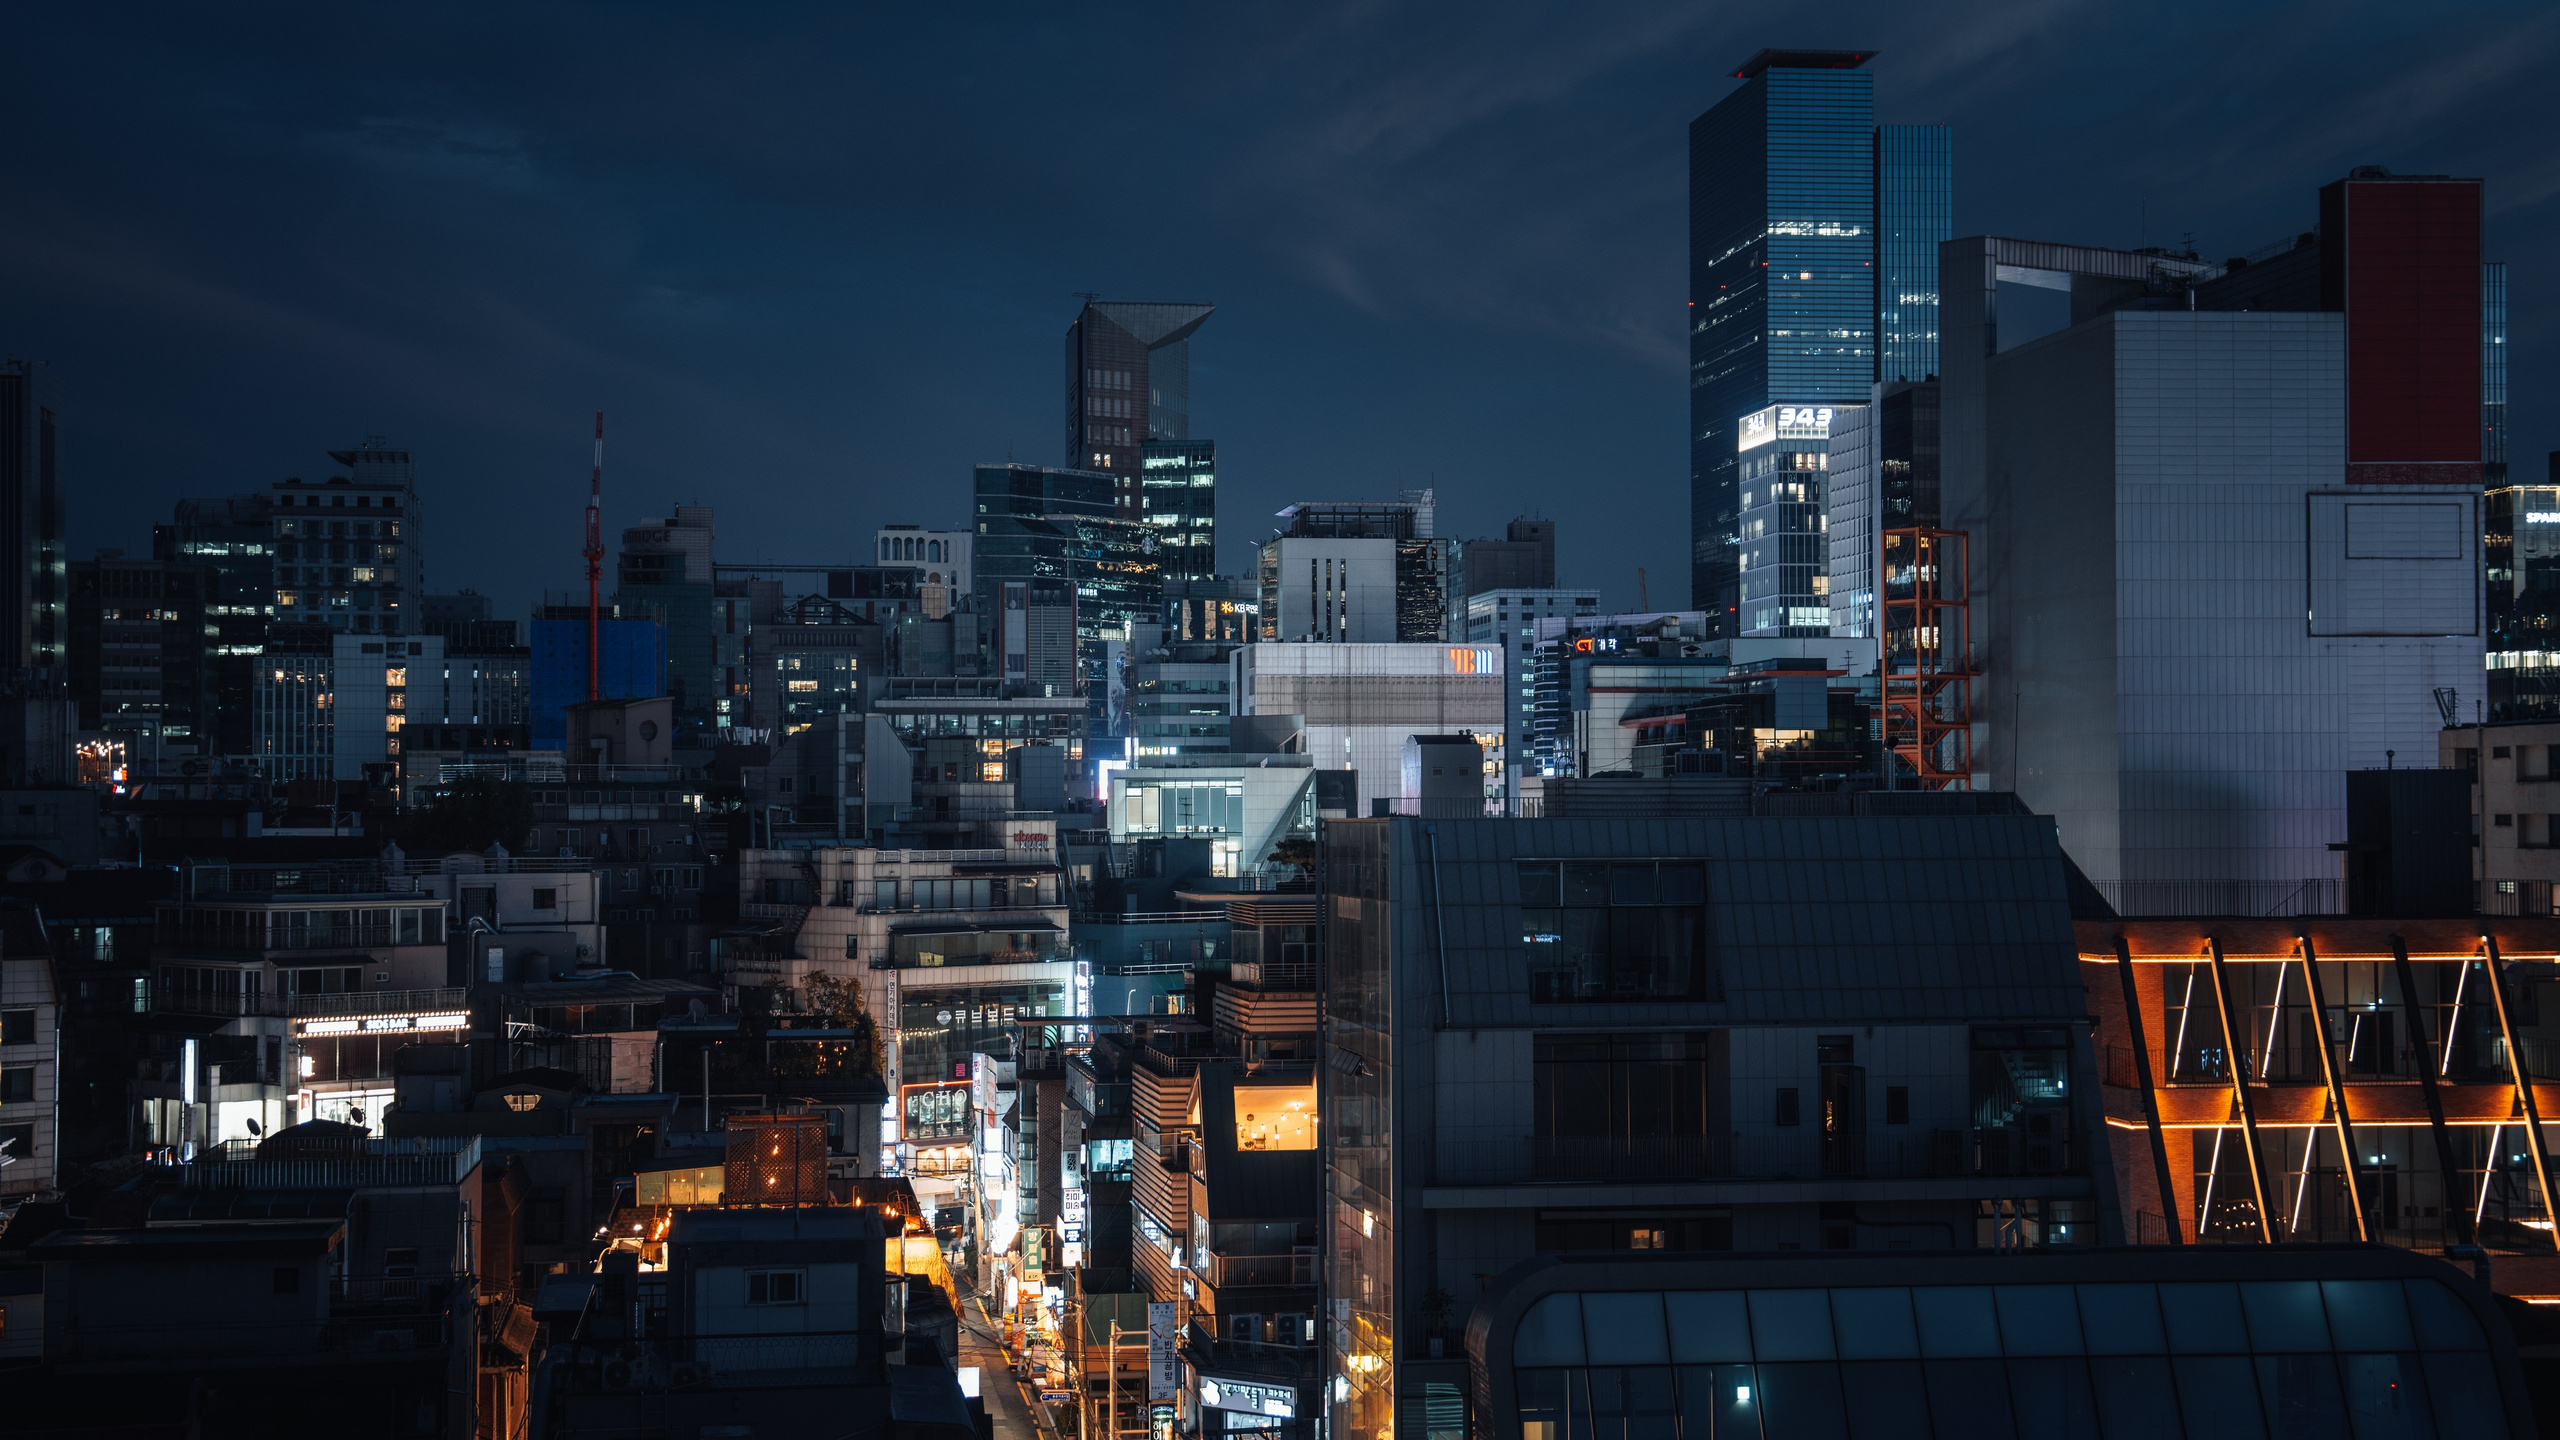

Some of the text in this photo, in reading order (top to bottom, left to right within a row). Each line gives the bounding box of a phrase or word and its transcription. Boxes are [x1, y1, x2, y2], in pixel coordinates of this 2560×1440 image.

[1747, 412, 1766, 436] 343
[1778, 408, 1833, 427] 343
[2526, 512, 2560, 523] SPAR
[1449, 648, 1493, 674] YBM
[365, 1018, 409, 1030] SIDE BAR
[1164, 1340, 1173, 1381] 반지공방
[1158, 1391, 1168, 1399] 3F
